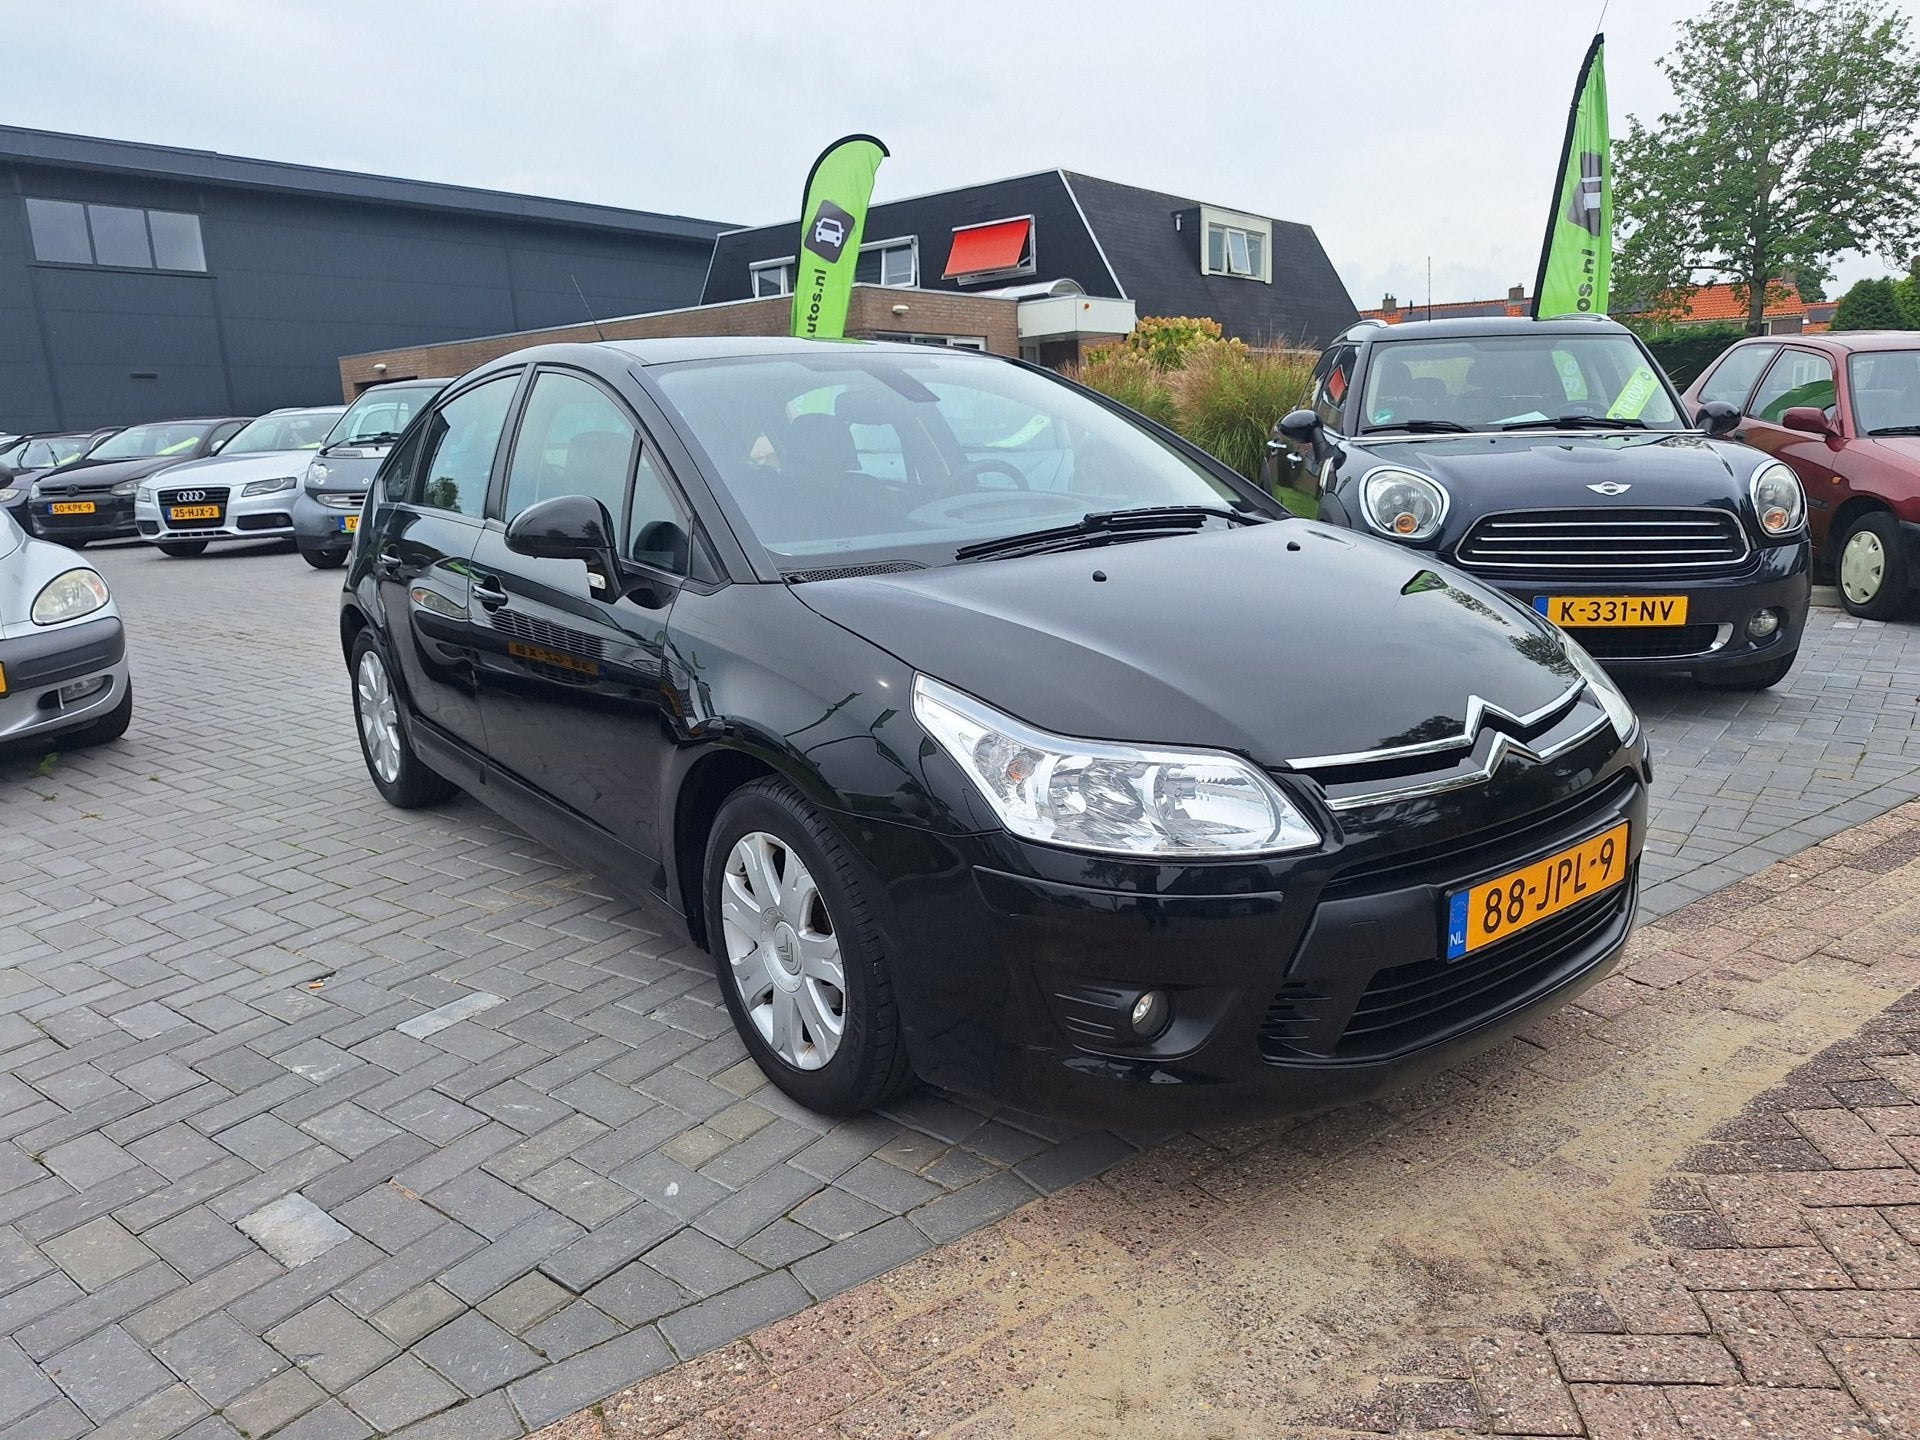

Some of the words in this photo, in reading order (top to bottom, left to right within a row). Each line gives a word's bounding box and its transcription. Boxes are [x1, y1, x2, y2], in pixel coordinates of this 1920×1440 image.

[1576, 249, 1595, 312] os.nl
[806, 268, 827, 338] utos.nl
[53, 503, 91, 513] 50-KPK-9
[174, 507, 214, 518] 25-HJX-2
[1560, 600, 1674, 622] K-331-NV
[1482, 837, 1615, 934] 88-JPL-9
[1449, 930, 1464, 949] NL
